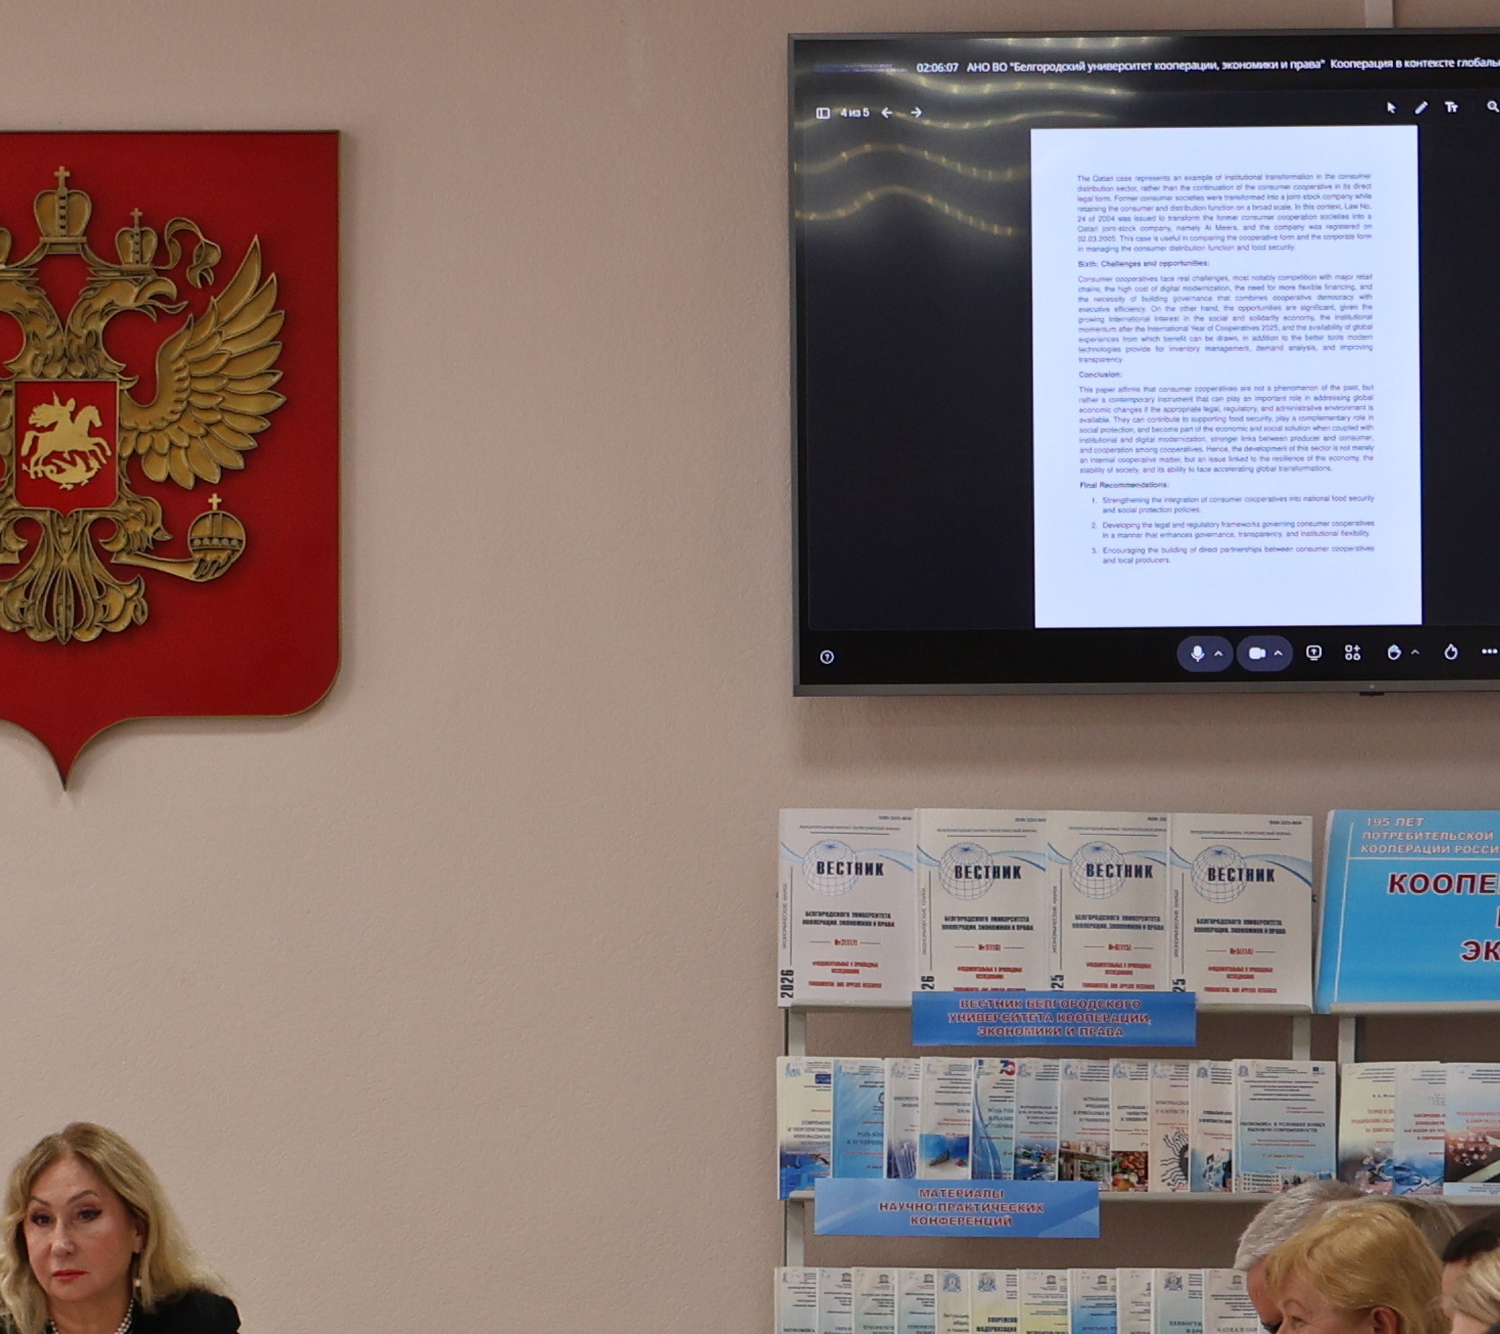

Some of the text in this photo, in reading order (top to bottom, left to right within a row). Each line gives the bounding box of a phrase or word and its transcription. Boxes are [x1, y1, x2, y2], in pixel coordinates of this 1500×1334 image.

[916, 59, 1325, 73] 02:06:07 АНО ВО "Белгородский университет кооперации, экономики и права"
[1331, 59, 1393, 71] Кооперация
[1396, 60, 1403, 68] в
[1404, 60, 1455, 69] контексте
[840, 108, 870, 118] 4 из 5
[1076, 174, 1091, 183] The
[1115, 175, 1133, 183] case
[1134, 174, 1171, 183] represents
[1183, 174, 1214, 183] example
[1214, 174, 1223, 182] of
[1224, 173, 1263, 182] institutional
[1264, 173, 1314, 181] transformation
[1324, 173, 1336, 181] the
[1337, 173, 1372, 181] consumer
[1100, 260, 1142, 269] Challenges
[1143, 260, 1158, 268] and
[1079, 481, 1098, 489] Final
[1102, 496, 1151, 506] Strengthening
[1163, 496, 1200, 506] integration
[1200, 495, 1208, 503] of
[1243, 495, 1288, 504] cooperatives
[1331, 494, 1347, 503] food
[1348, 494, 1375, 503] security
[1102, 506, 1116, 514] and
[1138, 506, 1173, 515] protection
[1102, 521, 1141, 531] Developing
[1153, 521, 1171, 531] legal
[1171, 521, 1186, 529] and
[1185, 520, 1220, 530] regulatory
[1220, 520, 1261, 528] frameworks
[1261, 521, 1296, 530] governing
[1331, 519, 1376, 529] cooperatives
[1159, 531, 1193, 539] enhances
[1285, 530, 1302, 538] and
[1300, 530, 1339, 538] institutional
[1102, 546, 1146, 556] Encouraging
[1147, 547, 1159, 555] the
[1160, 545, 1188, 556] building
[1189, 545, 1197, 554] of
[1198, 545, 1218, 553] direct
[1219, 545, 1263, 554] partnerships
[1263, 545, 1294, 553] between
[1331, 545, 1375, 554] cooperatives
[1102, 557, 1117, 565] and
[1117, 557, 1134, 565] local
[1366, 816, 1424, 827] 195 ЛЕТ
[1362, 829, 1495, 841] ПОТРЕБИТЕЛЬСКОЙ
[1360, 843, 1451, 856] КООПЕРАЦИИ
[817, 861, 884, 876] ВЕСТНИК
[955, 865, 1021, 880] ВЕСТНИК
[1086, 863, 1154, 878] ВЕСТНИК
[1208, 867, 1275, 882] ВЕСТНИК
[781, 969, 795, 998] 2026
[959, 998, 1142, 1011] ВЕСТНИК БЕЛГОРОДСКОГО
[948, 1012, 1055, 1024] УНИВЕРСИТЕТА
[976, 1026, 1124, 1038] ЭКОНОМИКИ И ПРАВА
[918, 1188, 1005, 1199] МАТЕРИАЛЫ
[879, 1201, 1045, 1214] НАУЧНО-ПРАКТИЧЕСКИХ
[910, 1214, 1014, 1227] КОНФЕРЕНЦИЙ
